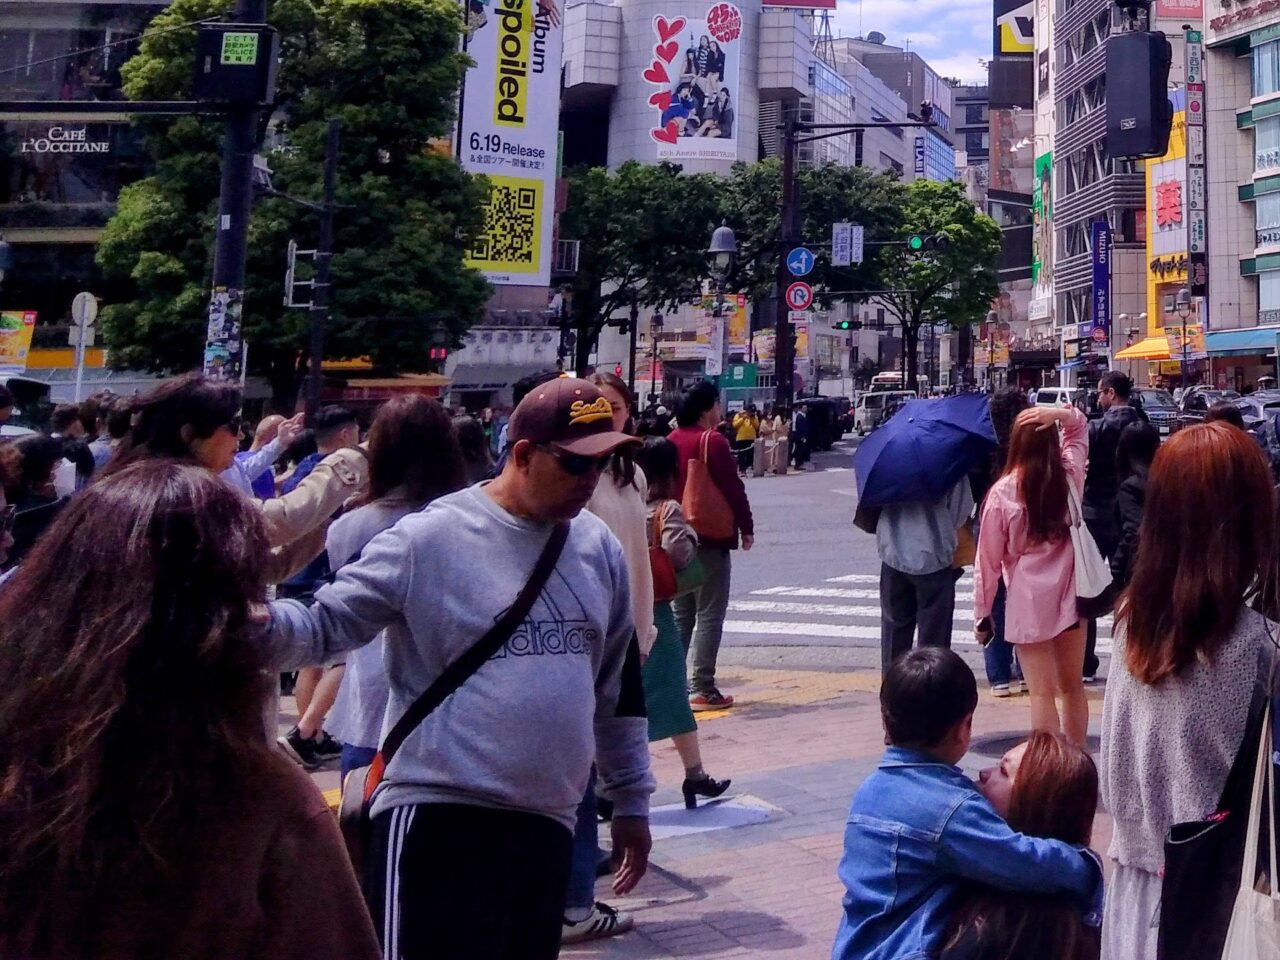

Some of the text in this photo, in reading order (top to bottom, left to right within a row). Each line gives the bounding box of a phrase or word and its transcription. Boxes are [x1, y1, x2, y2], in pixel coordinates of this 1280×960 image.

[532, 3, 550, 74] Album
[470, 132, 545, 158] 6.19 Release
[1156, 178, 1182, 227] 薬
[1099, 230, 1107, 264] MIZUHO
[488, 621, 597, 659] didas
